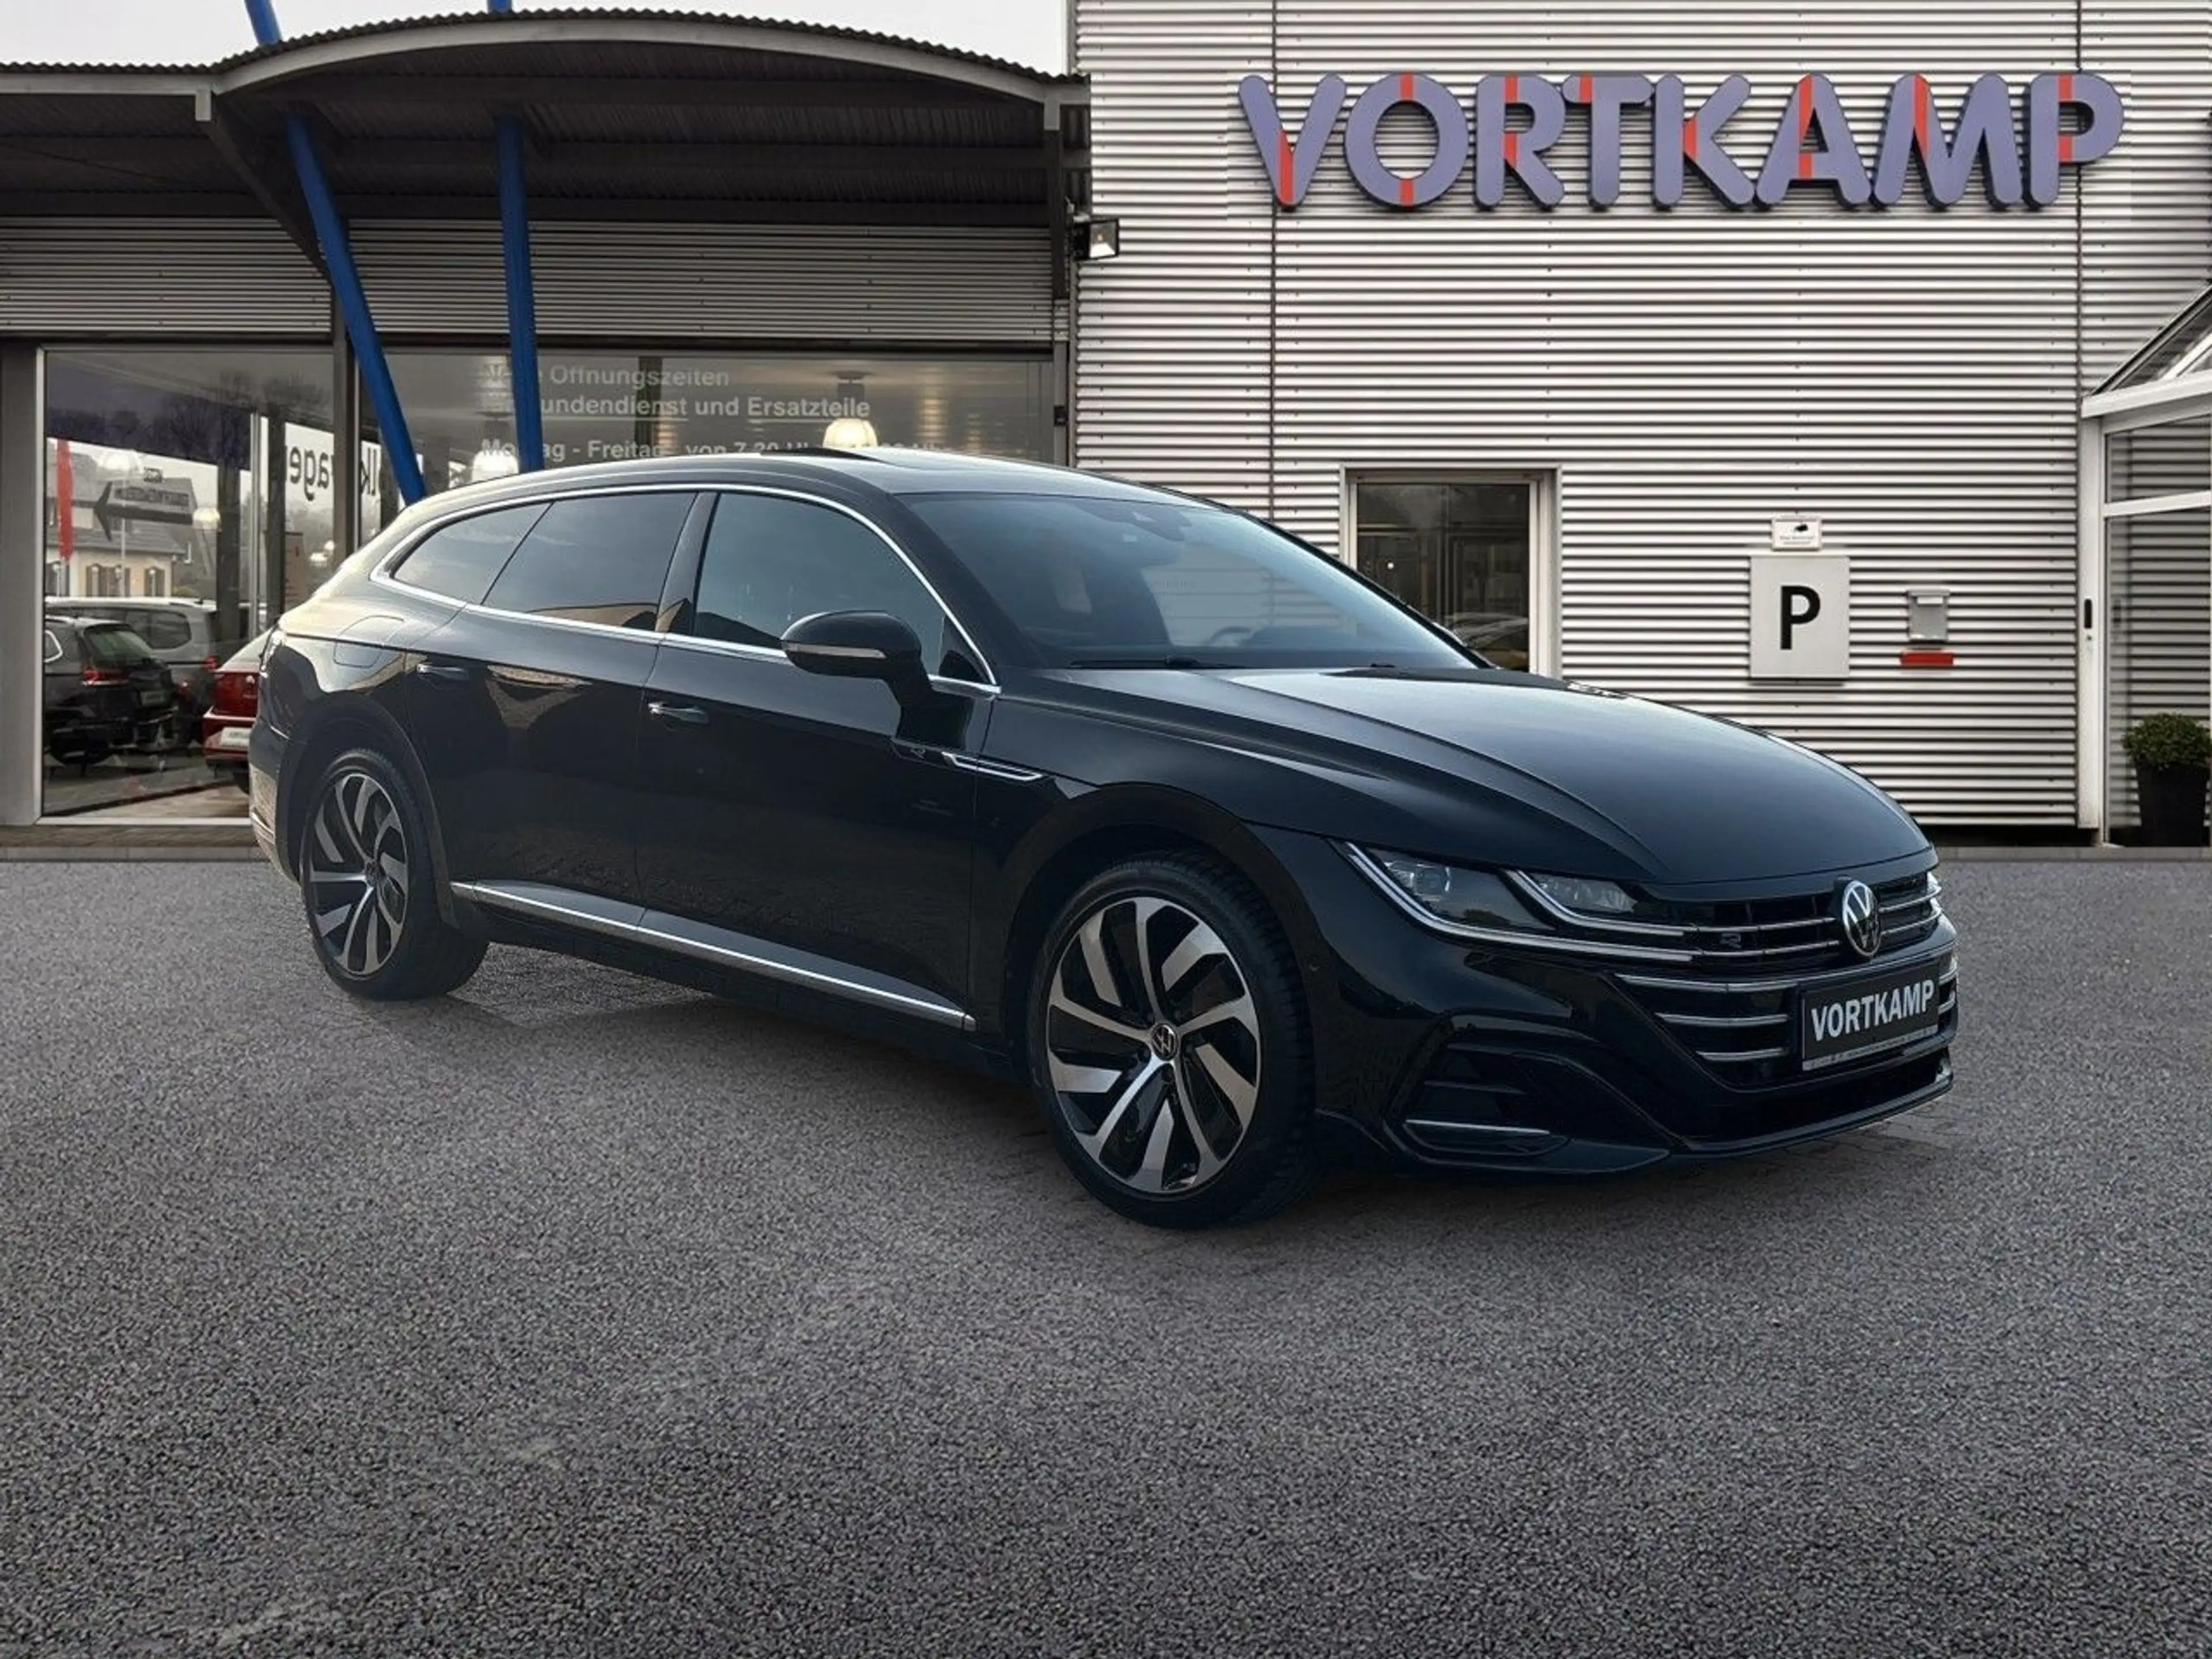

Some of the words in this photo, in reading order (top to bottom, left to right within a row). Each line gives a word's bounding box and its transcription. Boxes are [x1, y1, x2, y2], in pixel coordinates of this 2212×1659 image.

[1238, 73, 2124, 209] VORTKAMP
[540, 395, 688, 416] undendienst
[695, 397, 740, 416] und
[748, 396, 871, 417] Ersatzteile
[1780, 585, 1821, 650] P
[1811, 979, 1934, 1041] VORTKAMP
